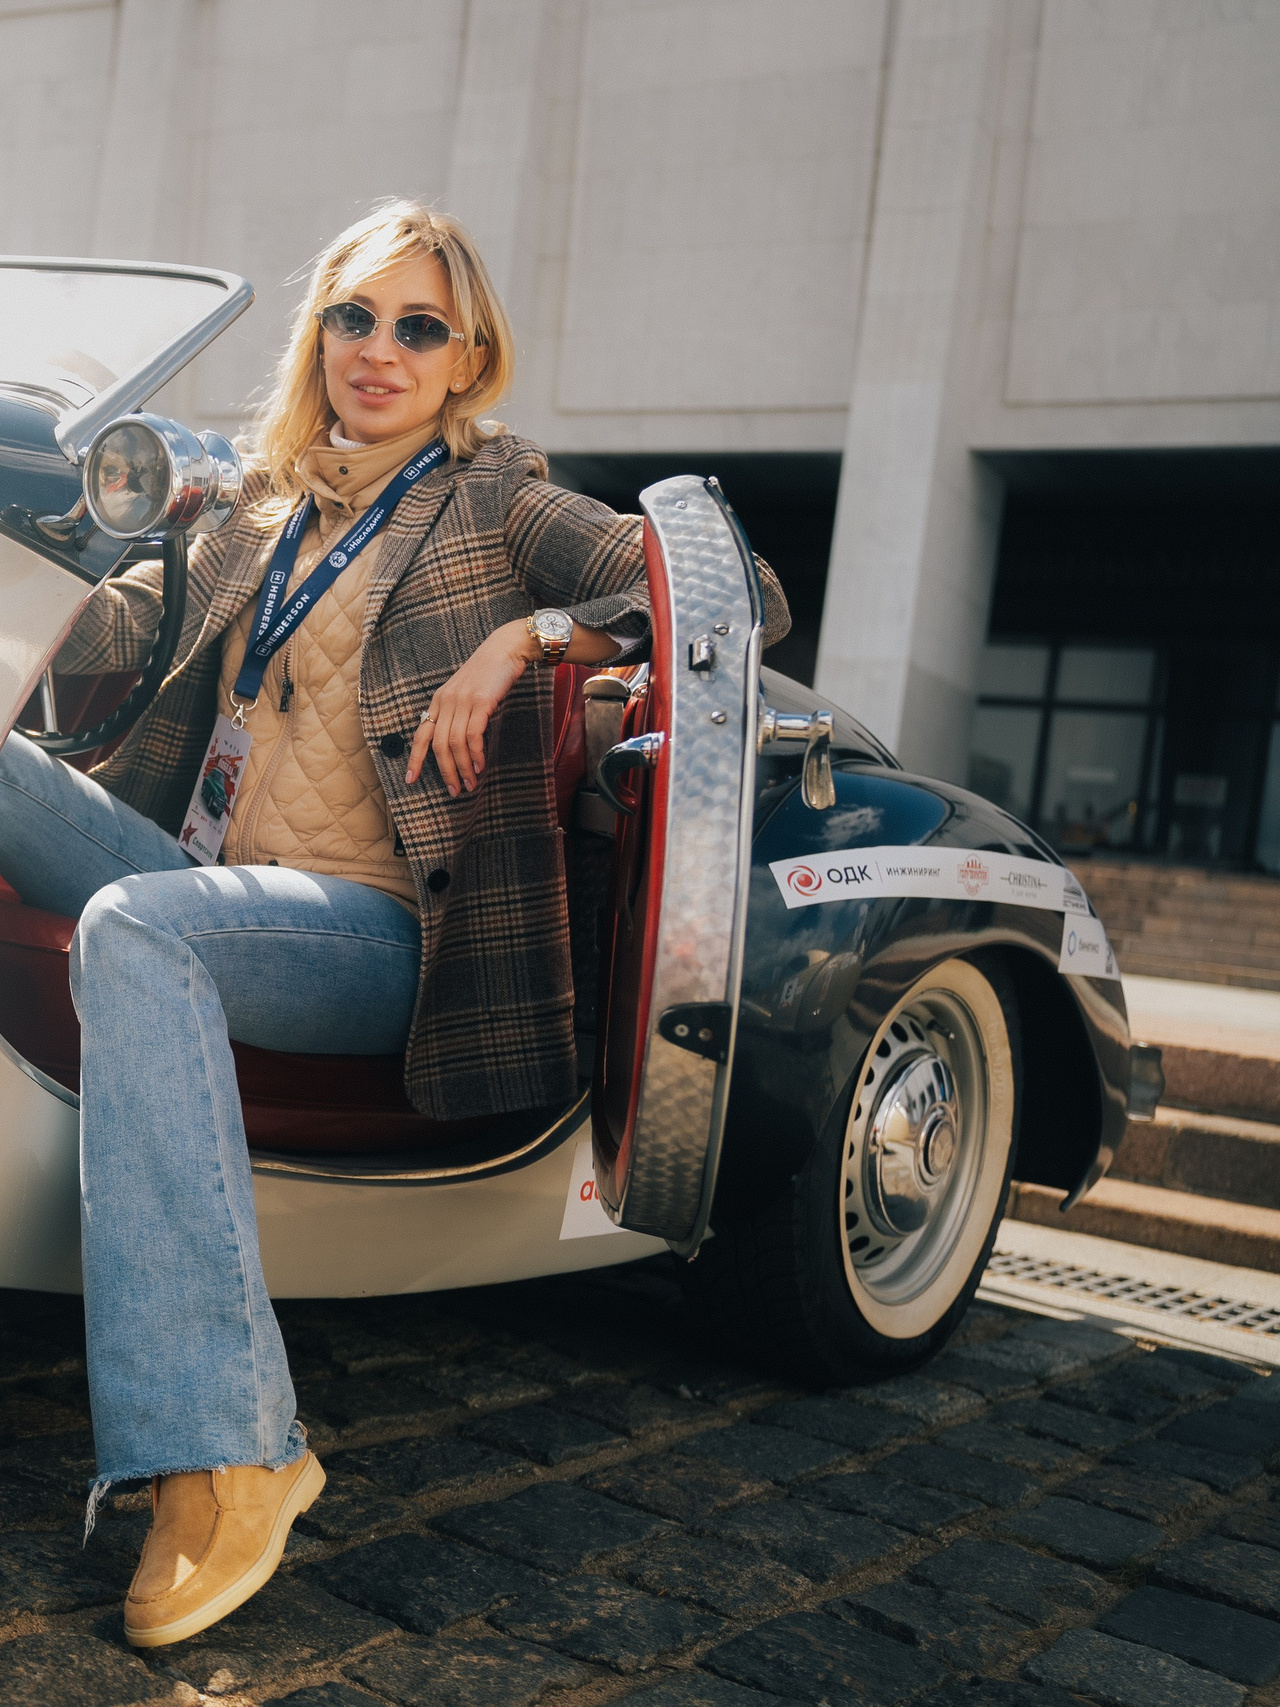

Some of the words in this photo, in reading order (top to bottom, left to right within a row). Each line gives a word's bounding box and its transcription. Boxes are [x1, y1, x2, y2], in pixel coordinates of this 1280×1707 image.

[265, 593, 310, 647] HENDERSON
[826, 865, 872, 885] ОДК
[886, 867, 940, 877] ИНЖИНИРИНГ
